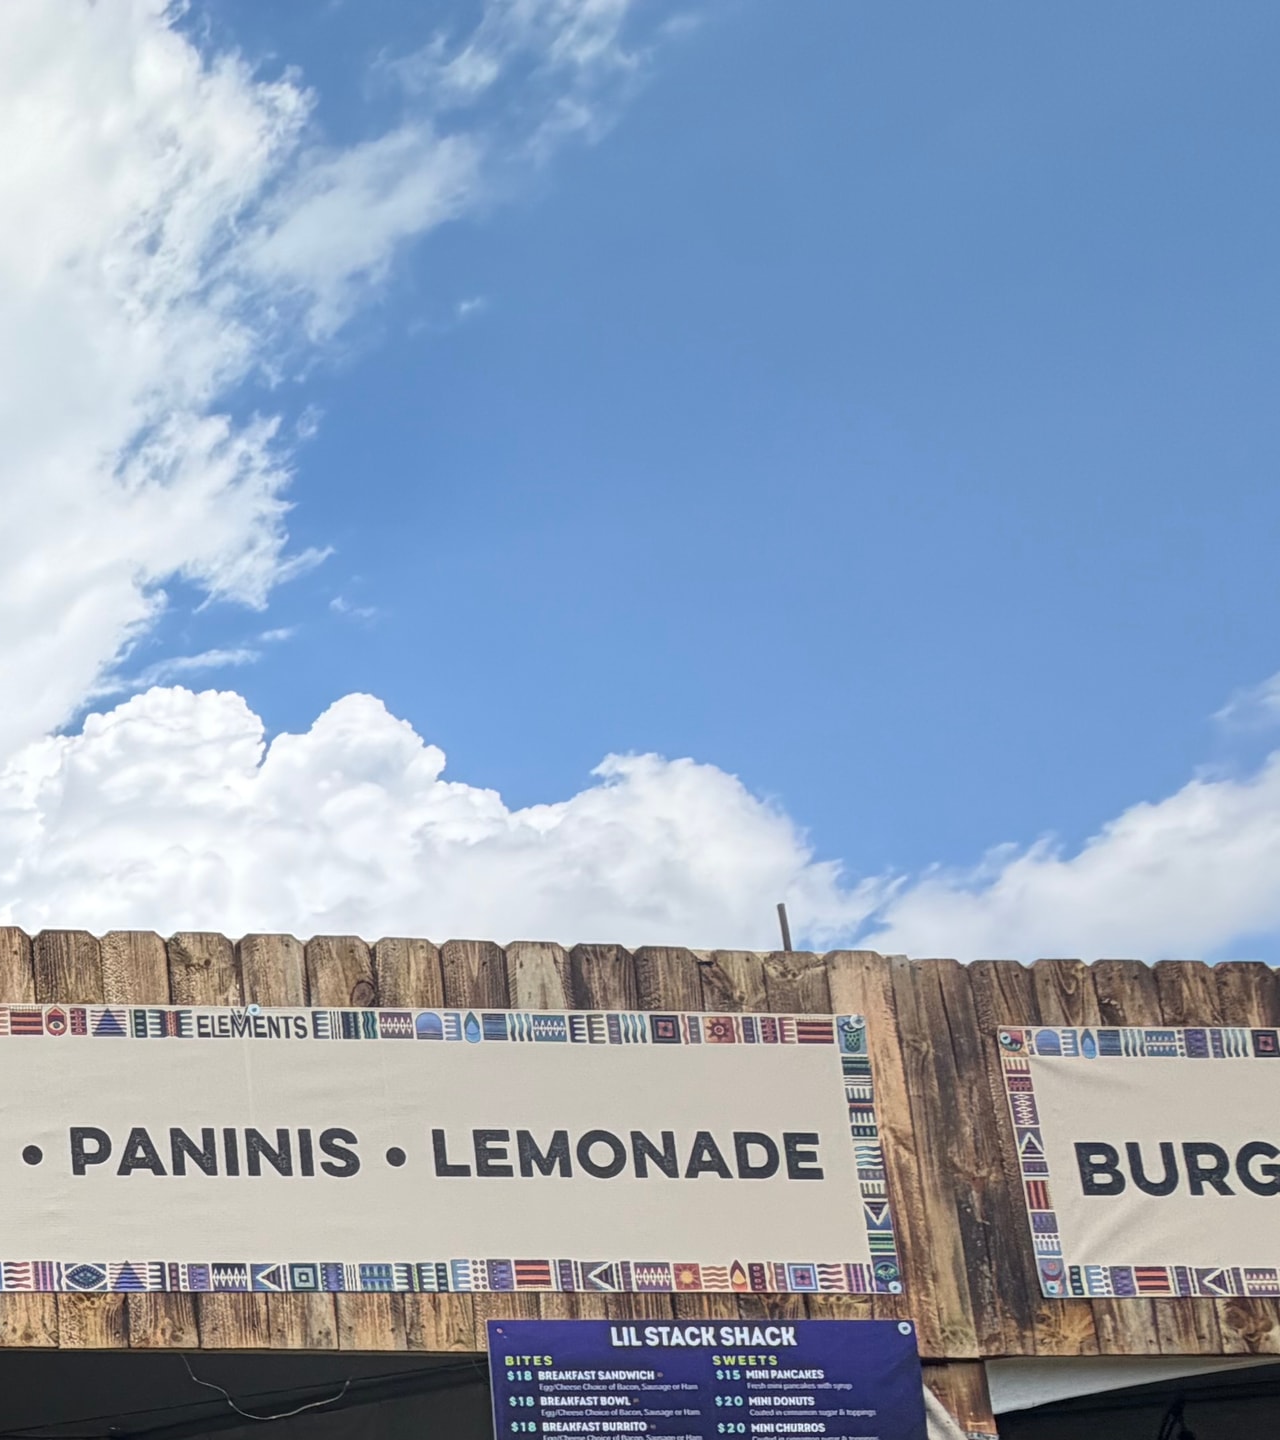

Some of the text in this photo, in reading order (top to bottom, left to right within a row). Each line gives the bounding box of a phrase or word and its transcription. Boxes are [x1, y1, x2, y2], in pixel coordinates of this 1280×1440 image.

[196, 1009, 308, 1039] ELEMENTS
[70, 1126, 360, 1178] PANINIS
[432, 1128, 824, 1180] LEMONADE
[1074, 1140, 1280, 1197] BURG
[610, 1326, 798, 1346] LIL STACK SHACK
[504, 1355, 553, 1366] BITES
[712, 1355, 778, 1366] SWEETS
[507, 1370, 655, 1381] $18 BREAKFAST SANDWICH
[716, 1369, 824, 1380] $15 MINI PANCAKES
[509, 1396, 632, 1407] $18 BREAKFAST BOWL
[715, 1396, 815, 1407] $20 MINI DONUTS
[511, 1422, 648, 1433] $18 BREAKFAST BURRITO
[717, 1422, 826, 1434] $20 MINI CHURROS
